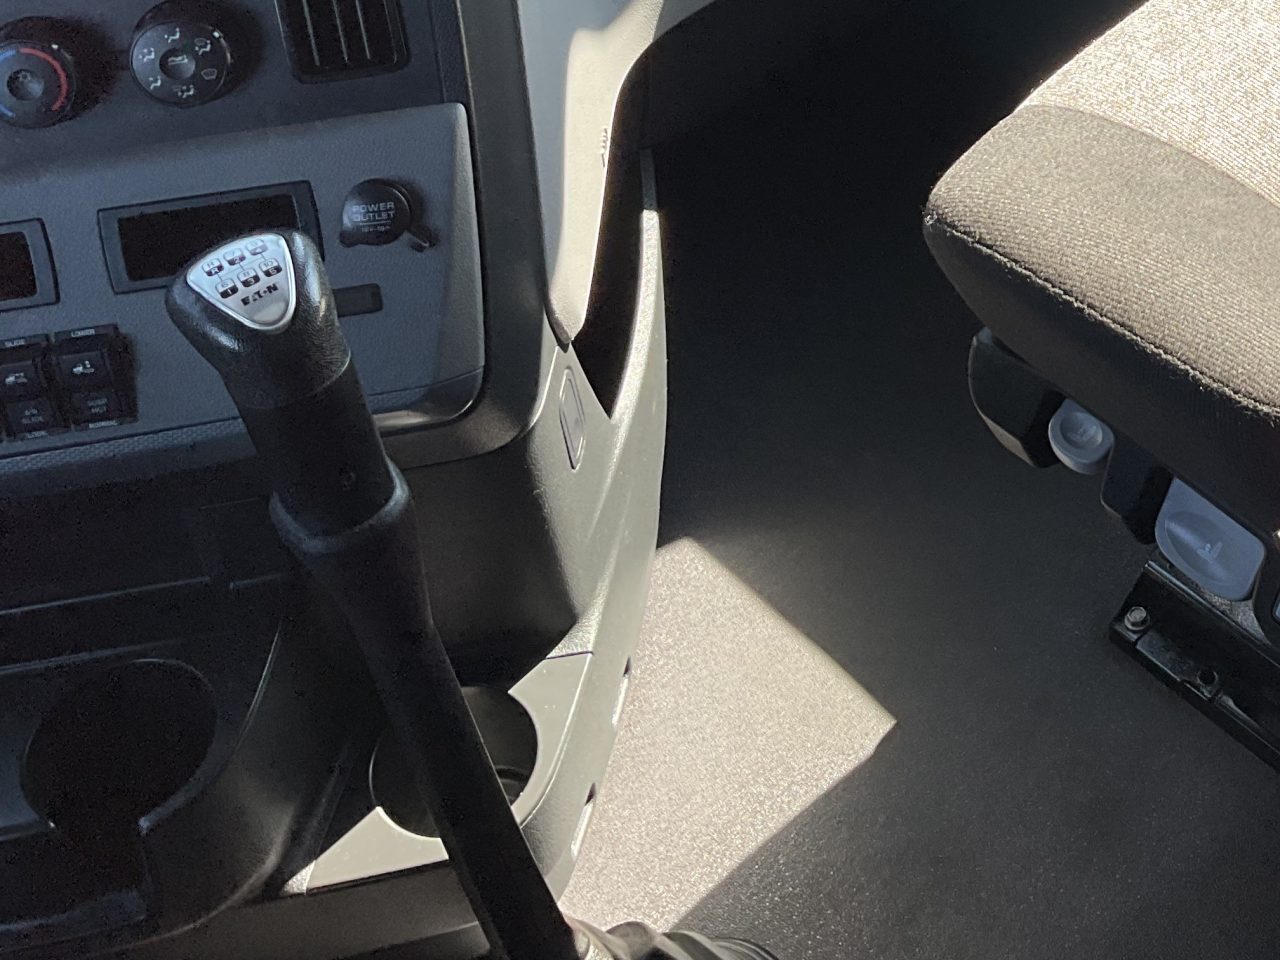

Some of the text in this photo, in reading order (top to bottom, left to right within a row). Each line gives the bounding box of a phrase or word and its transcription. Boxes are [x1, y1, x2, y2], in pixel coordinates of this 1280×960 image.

[351, 201, 395, 213] POWER
[351, 211, 396, 222] OUTLET
[240, 282, 279, 306] EATON
